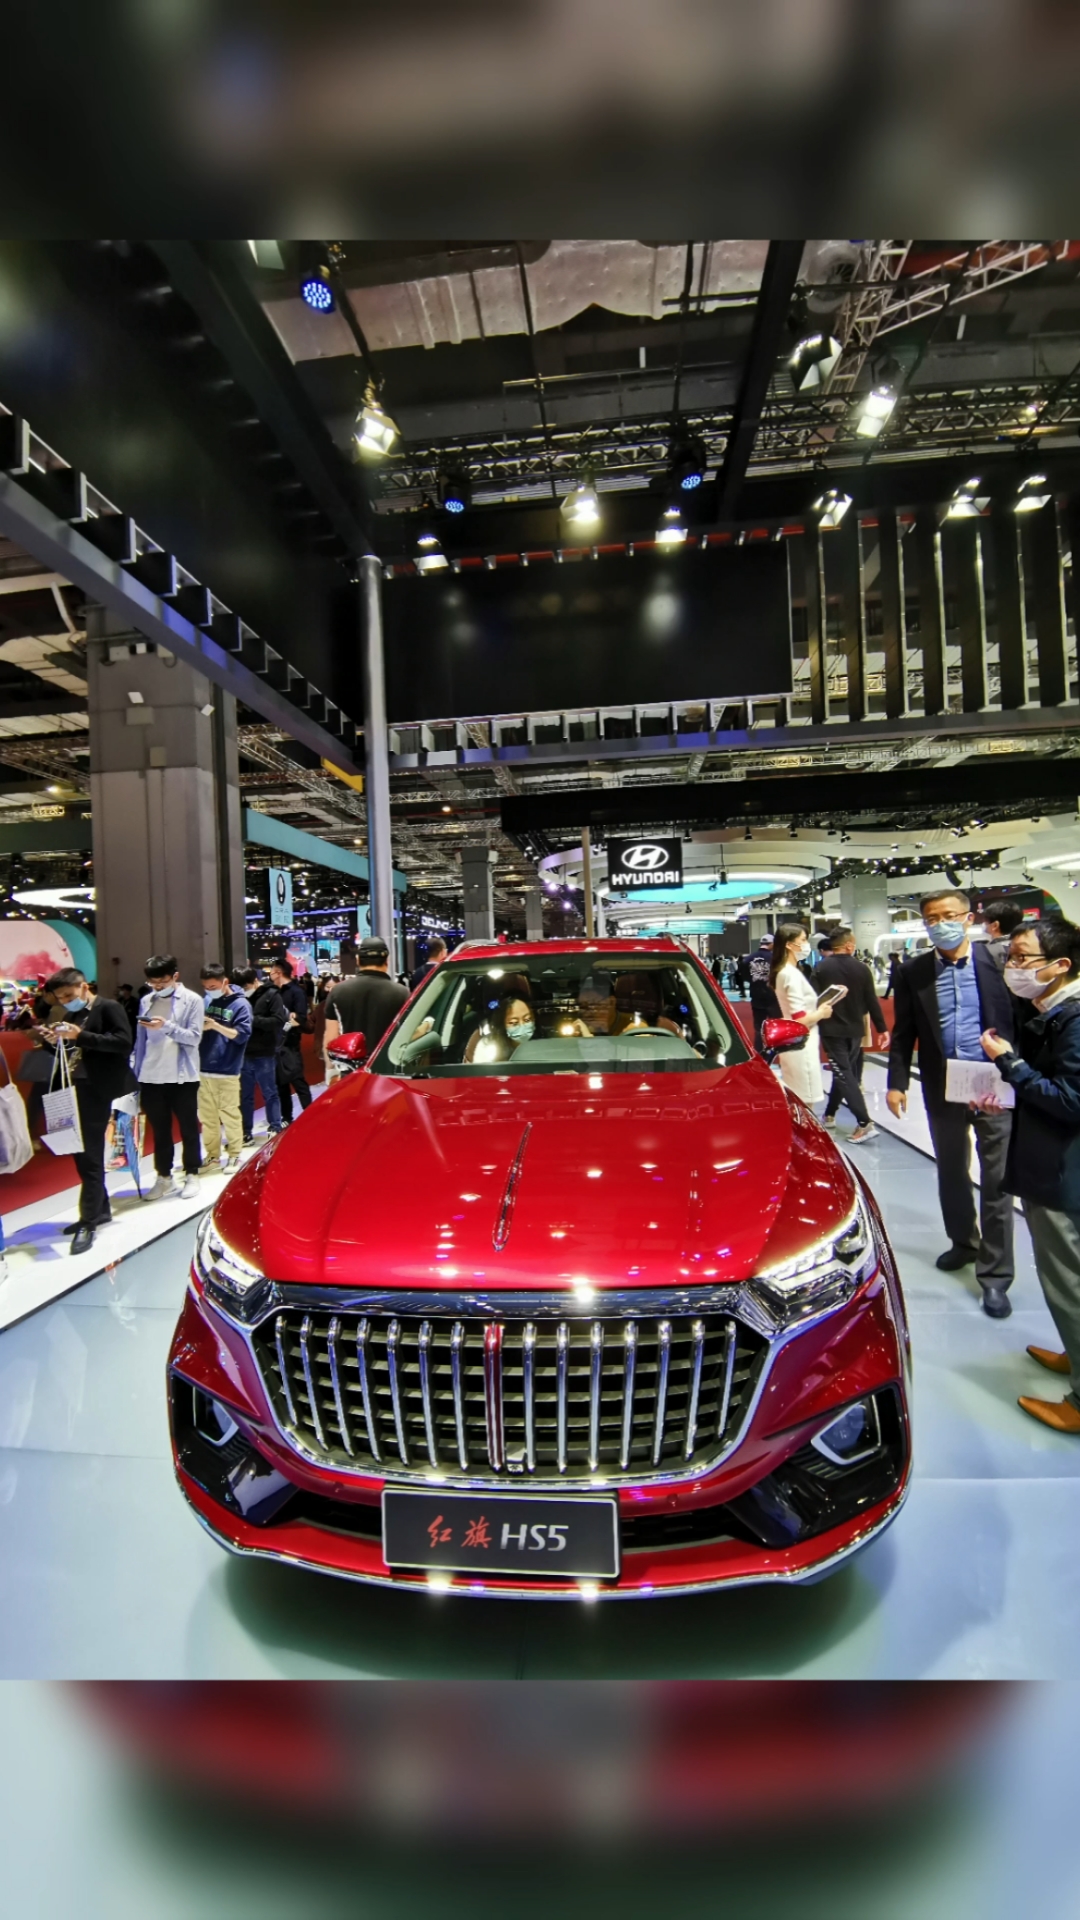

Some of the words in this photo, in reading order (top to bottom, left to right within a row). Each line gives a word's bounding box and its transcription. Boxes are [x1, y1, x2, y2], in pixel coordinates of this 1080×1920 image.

[612, 871, 680, 886] HYUNDAI
[427, 1515, 493, 1549] 红旗
[500, 1523, 569, 1552] HS5
